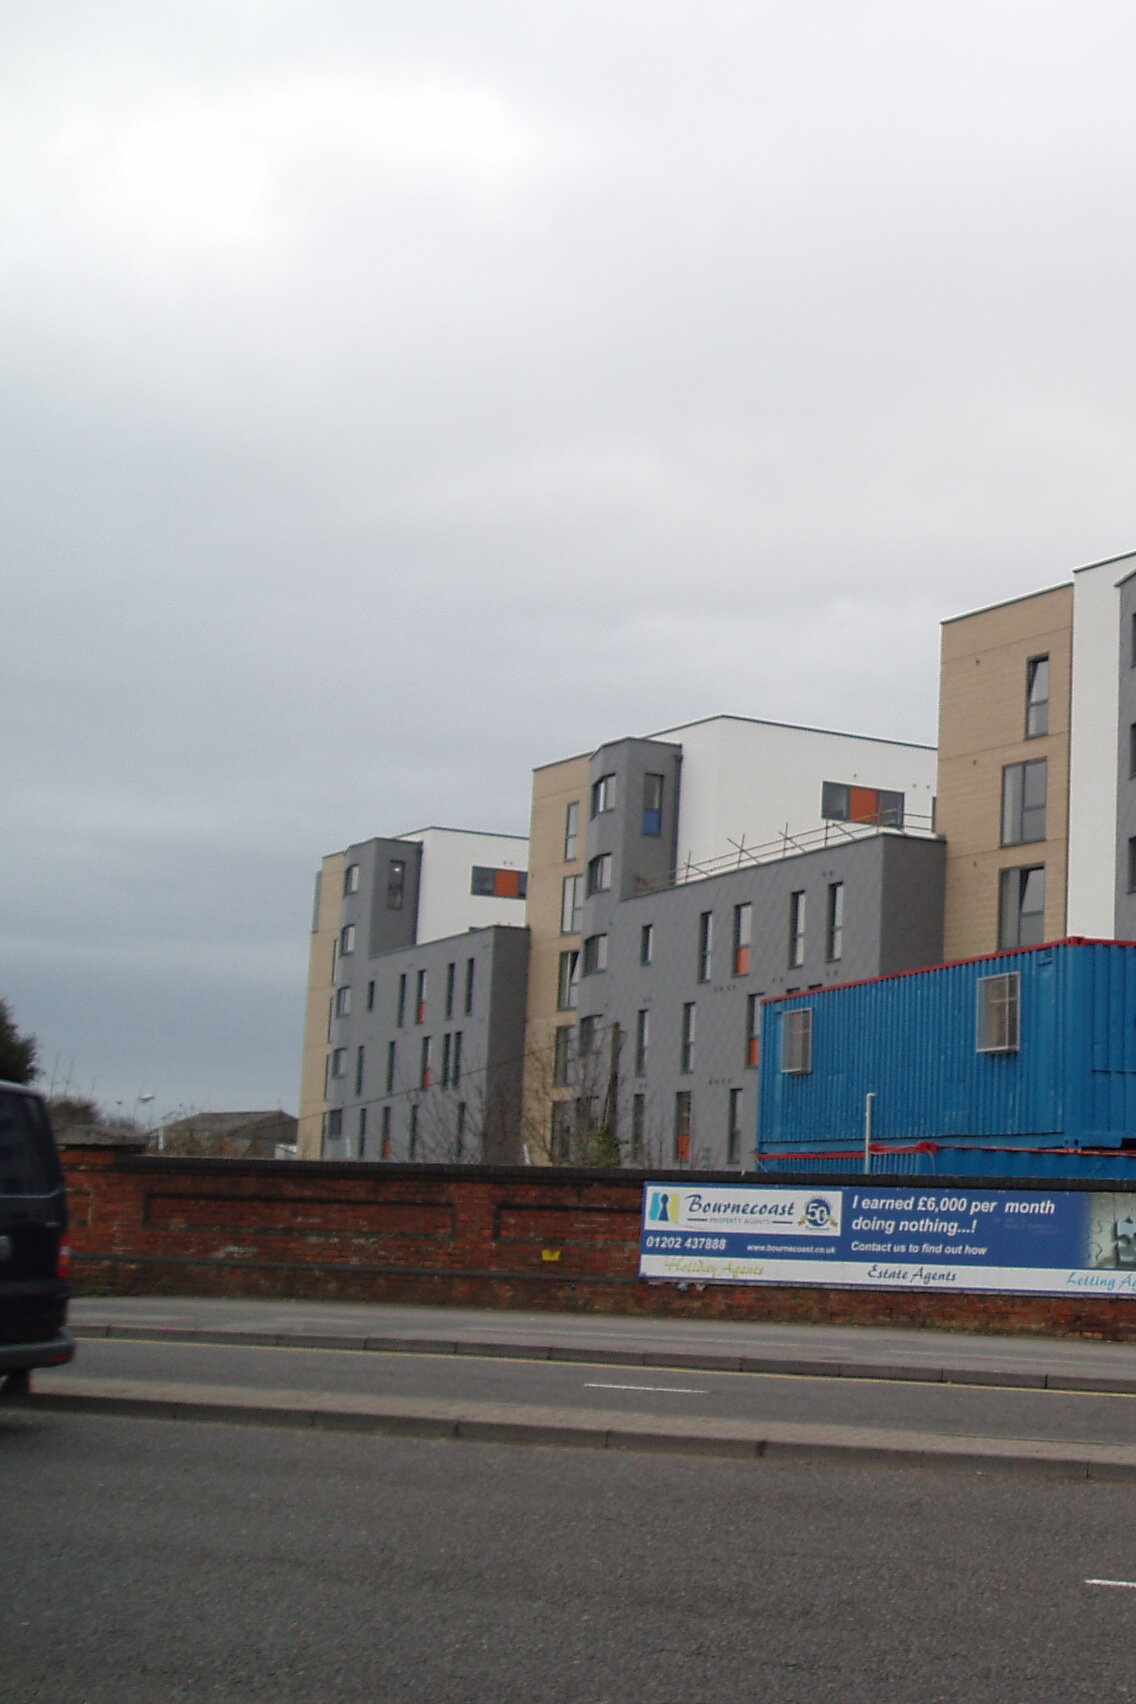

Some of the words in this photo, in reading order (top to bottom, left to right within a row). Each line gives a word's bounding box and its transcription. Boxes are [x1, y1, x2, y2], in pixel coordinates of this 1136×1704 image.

[685, 1194, 795, 1216] Bournecoast
[852, 1195, 859, 1209] I
[862, 1196, 914, 1210] earned
[917, 1197, 967, 1213] £6,000
[969, 1201, 997, 1215] per
[1004, 1200, 1055, 1214] month
[852, 1217, 895, 1234] doing
[899, 1218, 977, 1236] nothing...!
[646, 1236, 681, 1248] 01202
[684, 1237, 727, 1250] 437888
[851, 1241, 892, 1253] Contact
[893, 1244, 905, 1253] us
[908, 1244, 919, 1253] to
[922, 1243, 942, 1254] find
[944, 1245, 962, 1255] out
[964, 1245, 988, 1255] how
[868, 1264, 908, 1281] Estate
[909, 1266, 957, 1284] Agents
[1066, 1271, 1116, 1291] Letting
